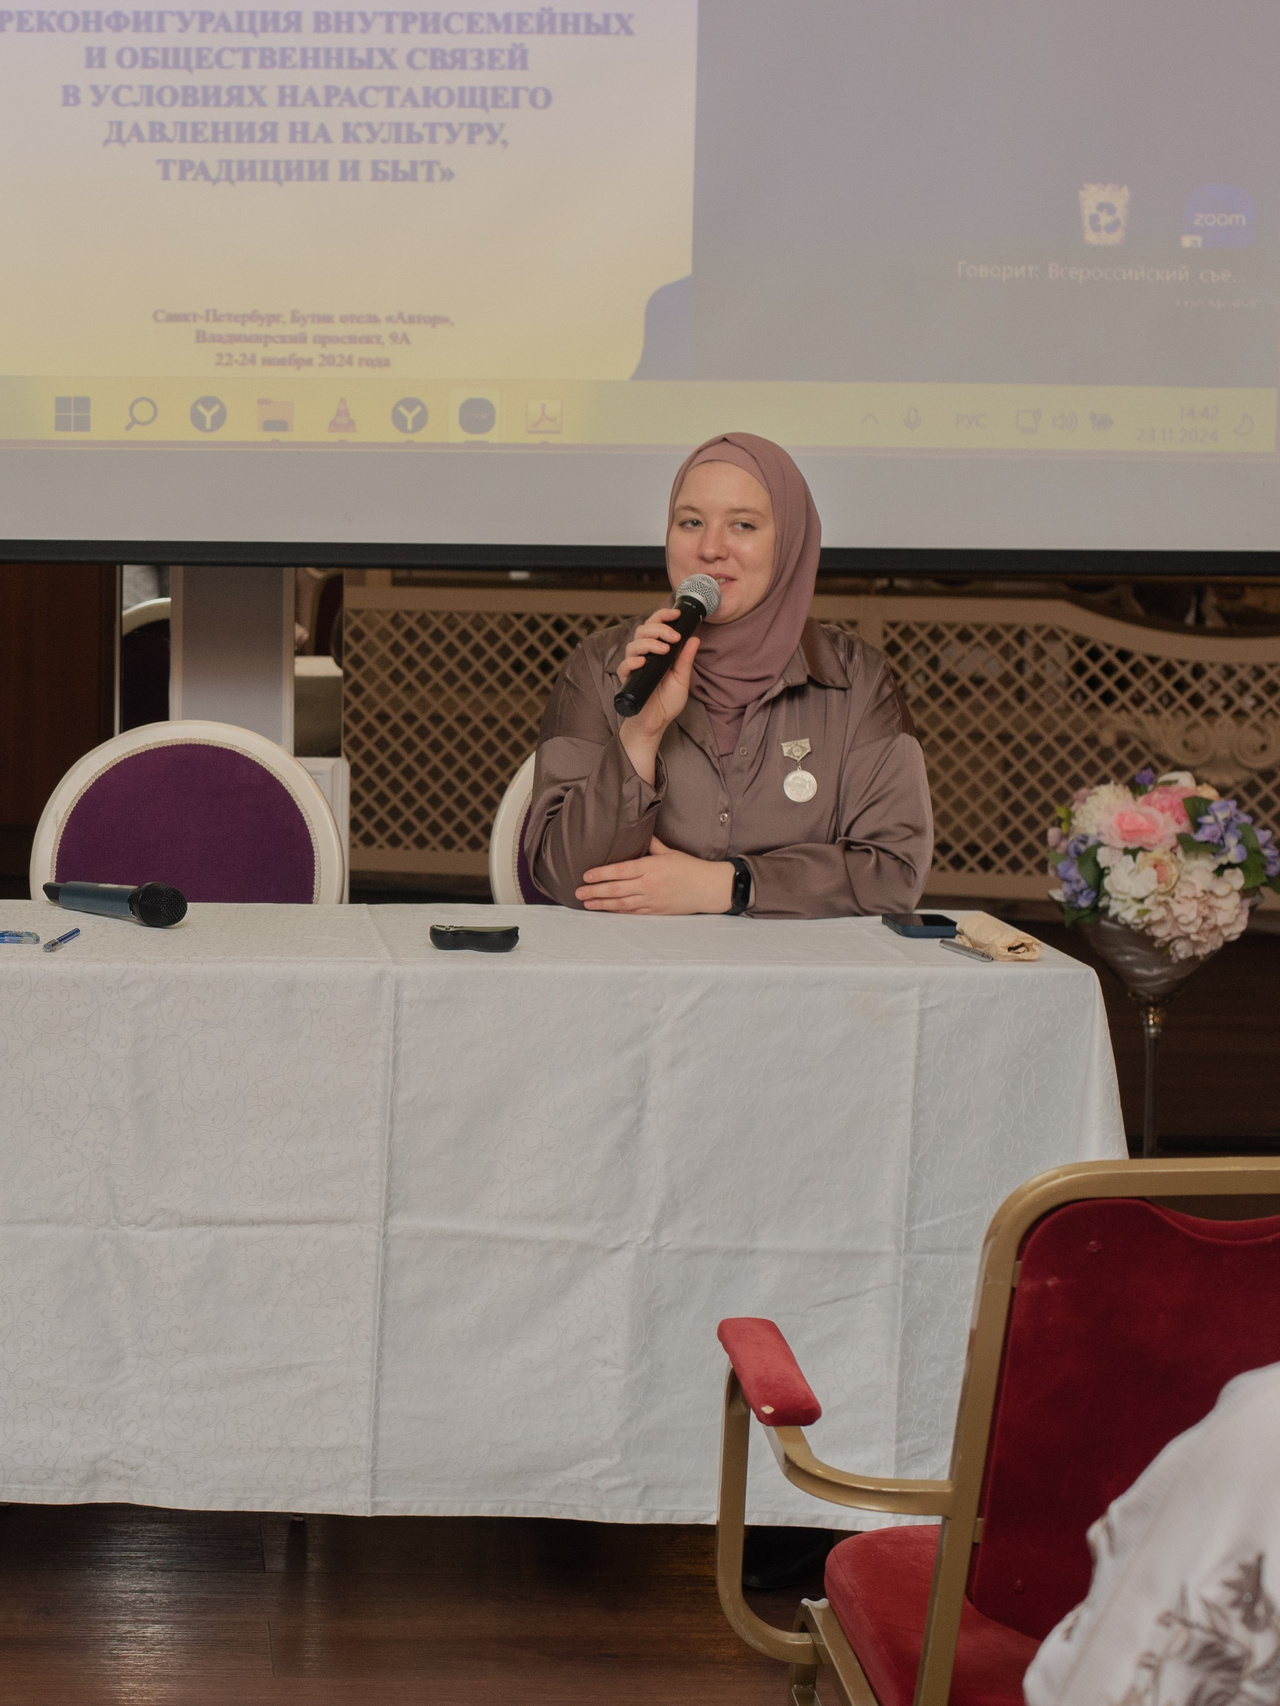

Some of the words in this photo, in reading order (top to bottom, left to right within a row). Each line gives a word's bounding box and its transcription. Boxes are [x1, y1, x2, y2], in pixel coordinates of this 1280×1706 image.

[312, 8, 637, 38] ВНУТРИСЕМЕЙНЫХ
[84, 47, 109, 72] И
[115, 47, 399, 74] ОБЩЕСТВЕННЫХ
[405, 44, 530, 73] СВЯЗЕЙ
[61, 85, 83, 109] В
[89, 85, 269, 110] УСЛОВИЯХ
[277, 86, 555, 115] НАРАСТАЮЩЕГО
[103, 121, 280, 148] ДАВЛЕНИЯ
[288, 122, 334, 146] НА
[342, 122, 511, 150] КУЛЬТУРУ,
[156, 158, 331, 188] ТРАДИЦИИ
[339, 160, 363, 183] И
[370, 160, 457, 184] БЫТ»
[1193, 212, 1248, 228] zoom
[1047, 261, 1191, 286] Всероссийский
[152, 308, 288, 328] Санкт-Петербург,
[195, 329, 309, 348] Владимирский
[214, 353, 258, 369] 22-24
[261, 353, 315, 371] ноября
[318, 354, 355, 369] 2024
[357, 358, 393, 370] года
[955, 412, 987, 430] РУС
